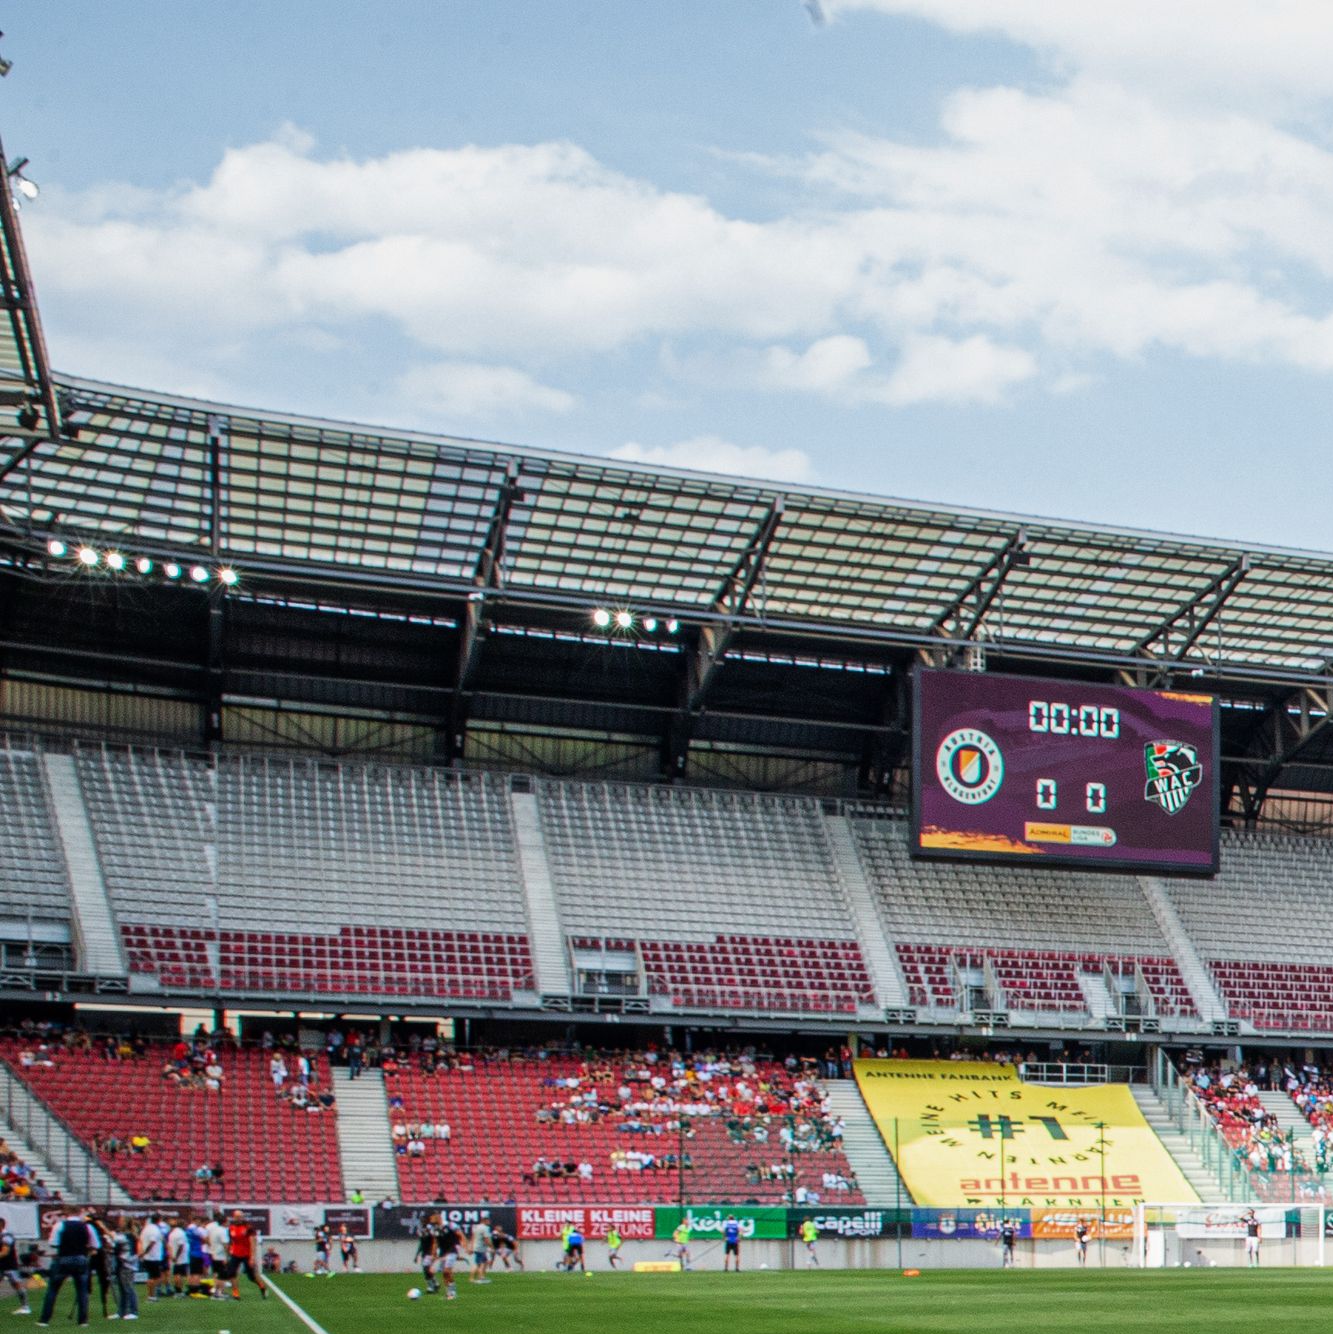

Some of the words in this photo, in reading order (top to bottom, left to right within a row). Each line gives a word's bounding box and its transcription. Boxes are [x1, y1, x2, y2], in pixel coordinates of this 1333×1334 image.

[1029, 700, 1119, 738] 00:00
[944, 732, 996, 755] AUSTRIA
[1154, 770, 1194, 793] WAC
[1037, 778, 1057, 810] 0
[1087, 782, 1106, 813] 0
[866, 1071, 935, 1080] ANTENNE
[940, 1073, 1012, 1081] FANBANK
[948, 1090, 1023, 1103] HITS
[967, 1113, 1070, 1141] #1
[960, 1172, 1142, 1190] antenne
[521, 1210, 584, 1222] KLEINE
[591, 1210, 653, 1222] KLEINE
[686, 1209, 755, 1237] kelg
[814, 1211, 883, 1234] capelli
[522, 1223, 584, 1236] ZEITUG
[591, 1223, 653, 1236] ZETUNG
